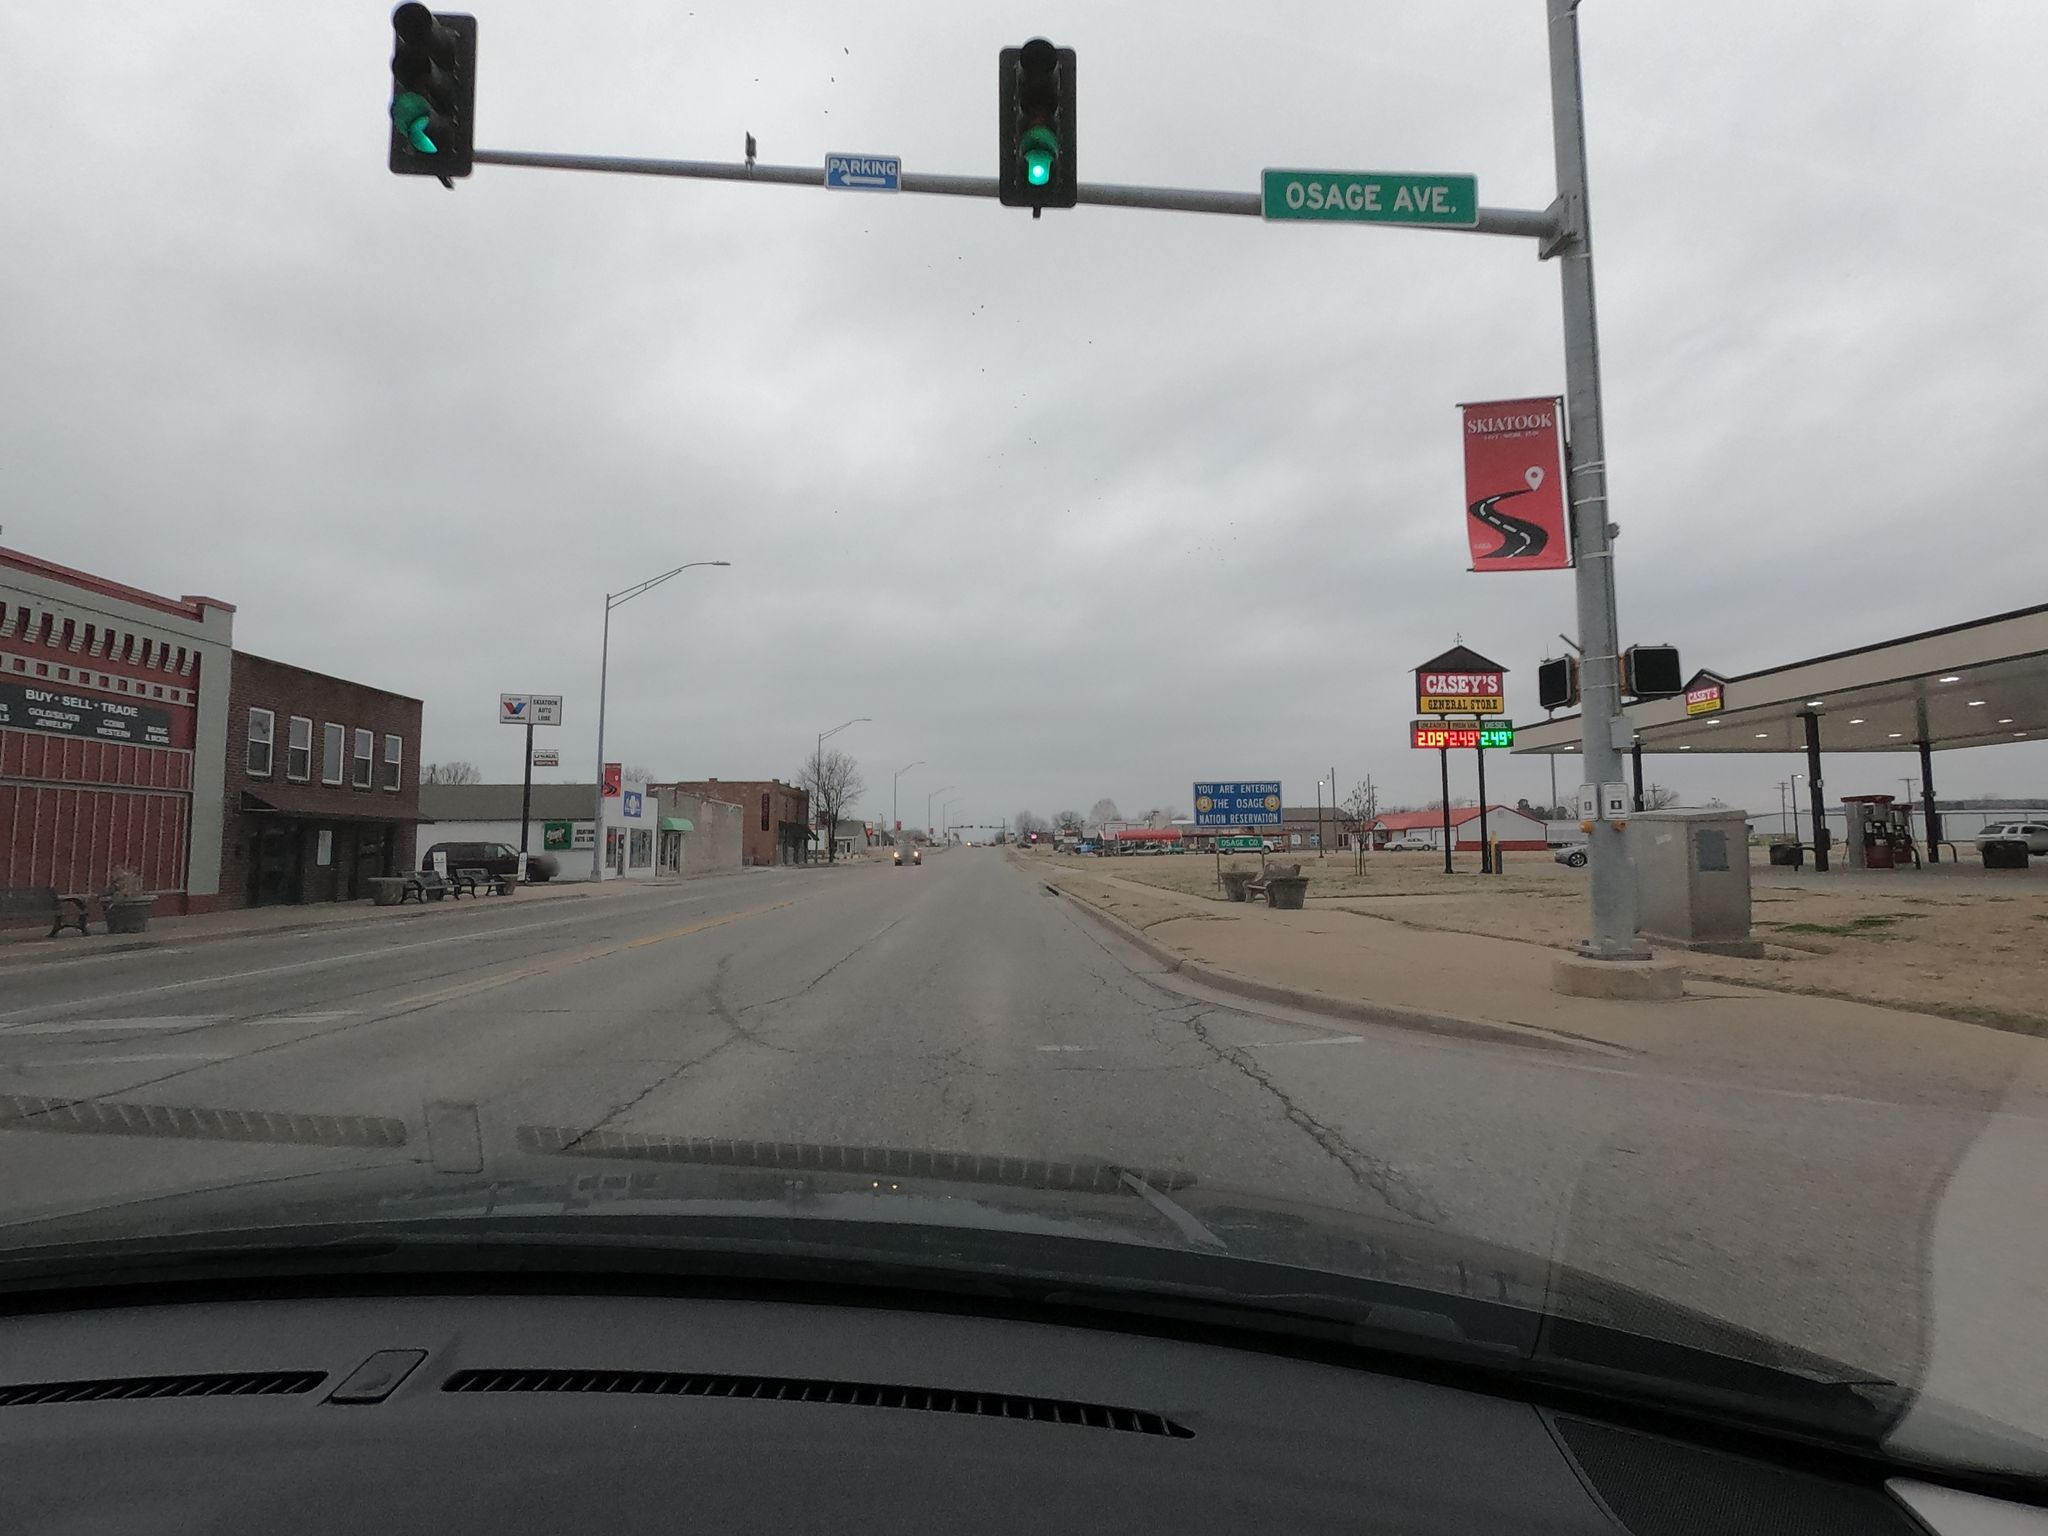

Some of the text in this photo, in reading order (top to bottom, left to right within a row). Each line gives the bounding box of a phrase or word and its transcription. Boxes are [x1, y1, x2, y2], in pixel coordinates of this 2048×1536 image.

[829, 158, 897, 176] PARKING
[1285, 181, 1457, 214] OSAGE AVE.
[1467, 413, 1552, 434] SKIATOOK
[1426, 675, 1498, 694] CASEY'S
[25, 689, 139, 717] BUY SELL TRADE
[1428, 699, 1498, 710] GENERAL STORE
[1198, 784, 1278, 794] YOU ARE ENTERING
[1213, 798, 1264, 809] THE OSAGE
[1200, 813, 1278, 824] NATION RESERVATION
